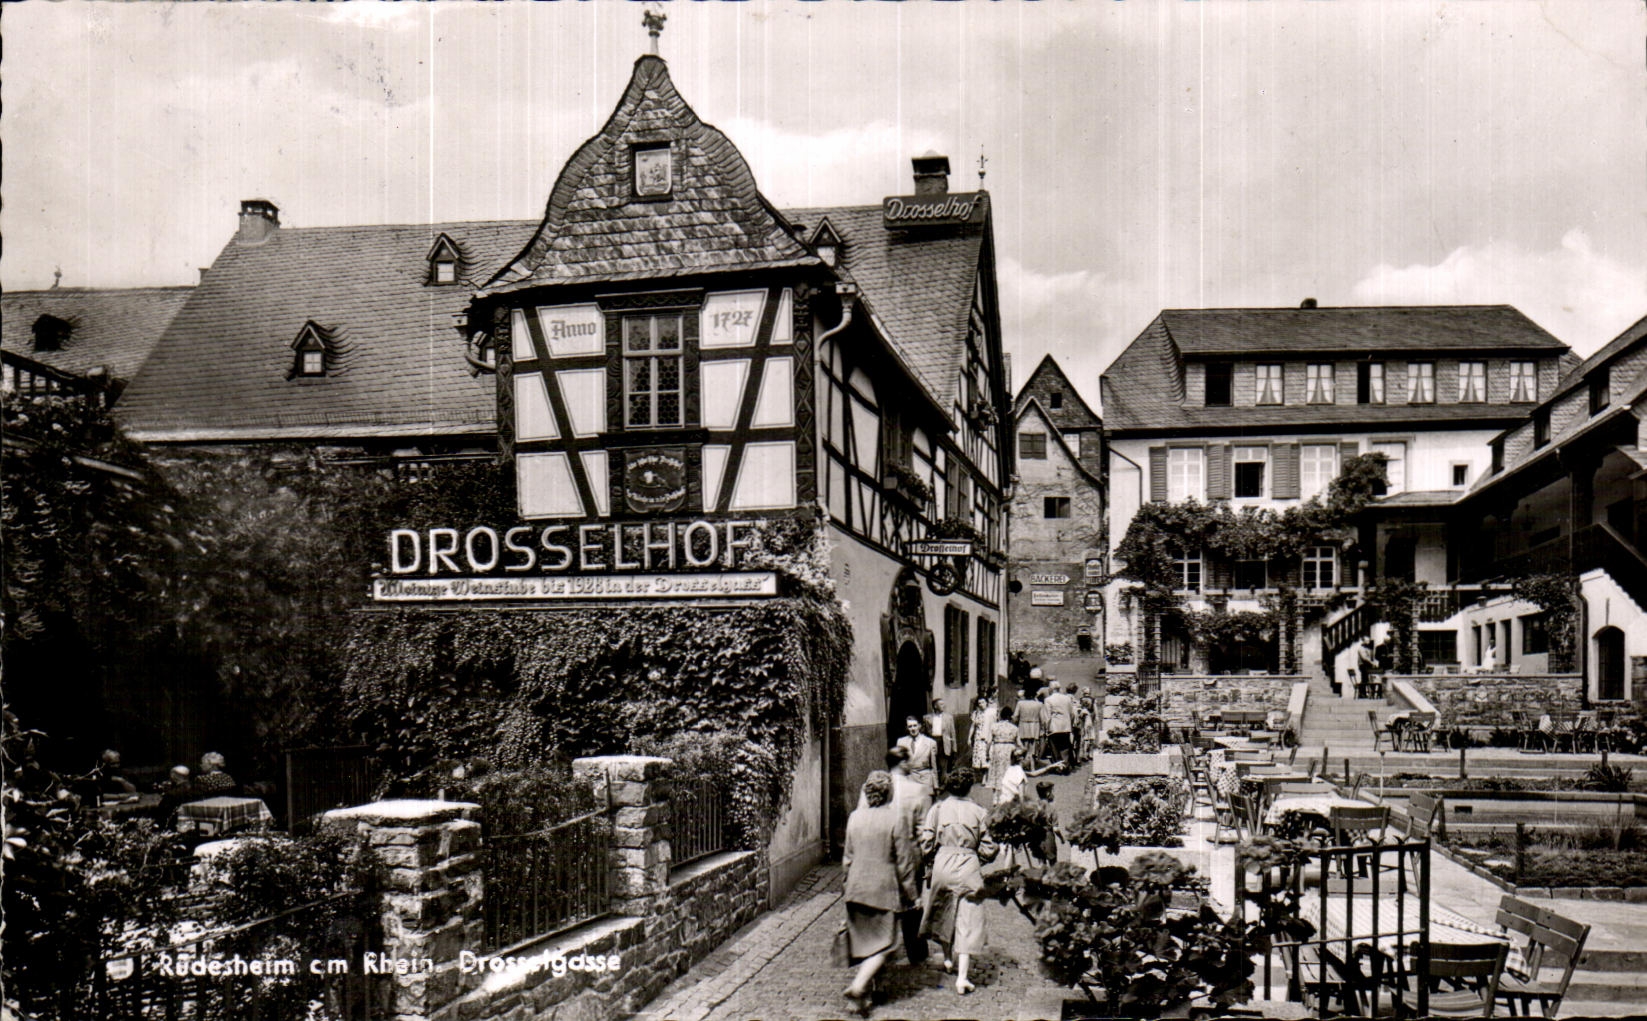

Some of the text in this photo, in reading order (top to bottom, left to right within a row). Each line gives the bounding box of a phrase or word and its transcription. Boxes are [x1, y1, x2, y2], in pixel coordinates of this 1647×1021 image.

[885, 194, 982, 221] Drosselhof
[551, 320, 597, 340] Anno
[709, 310, 754, 332] 1727
[391, 521, 754, 573] DROSSELHOF
[541, 576, 565, 594] bis
[605, 577, 622, 594] in
[626, 575, 650, 593] der
